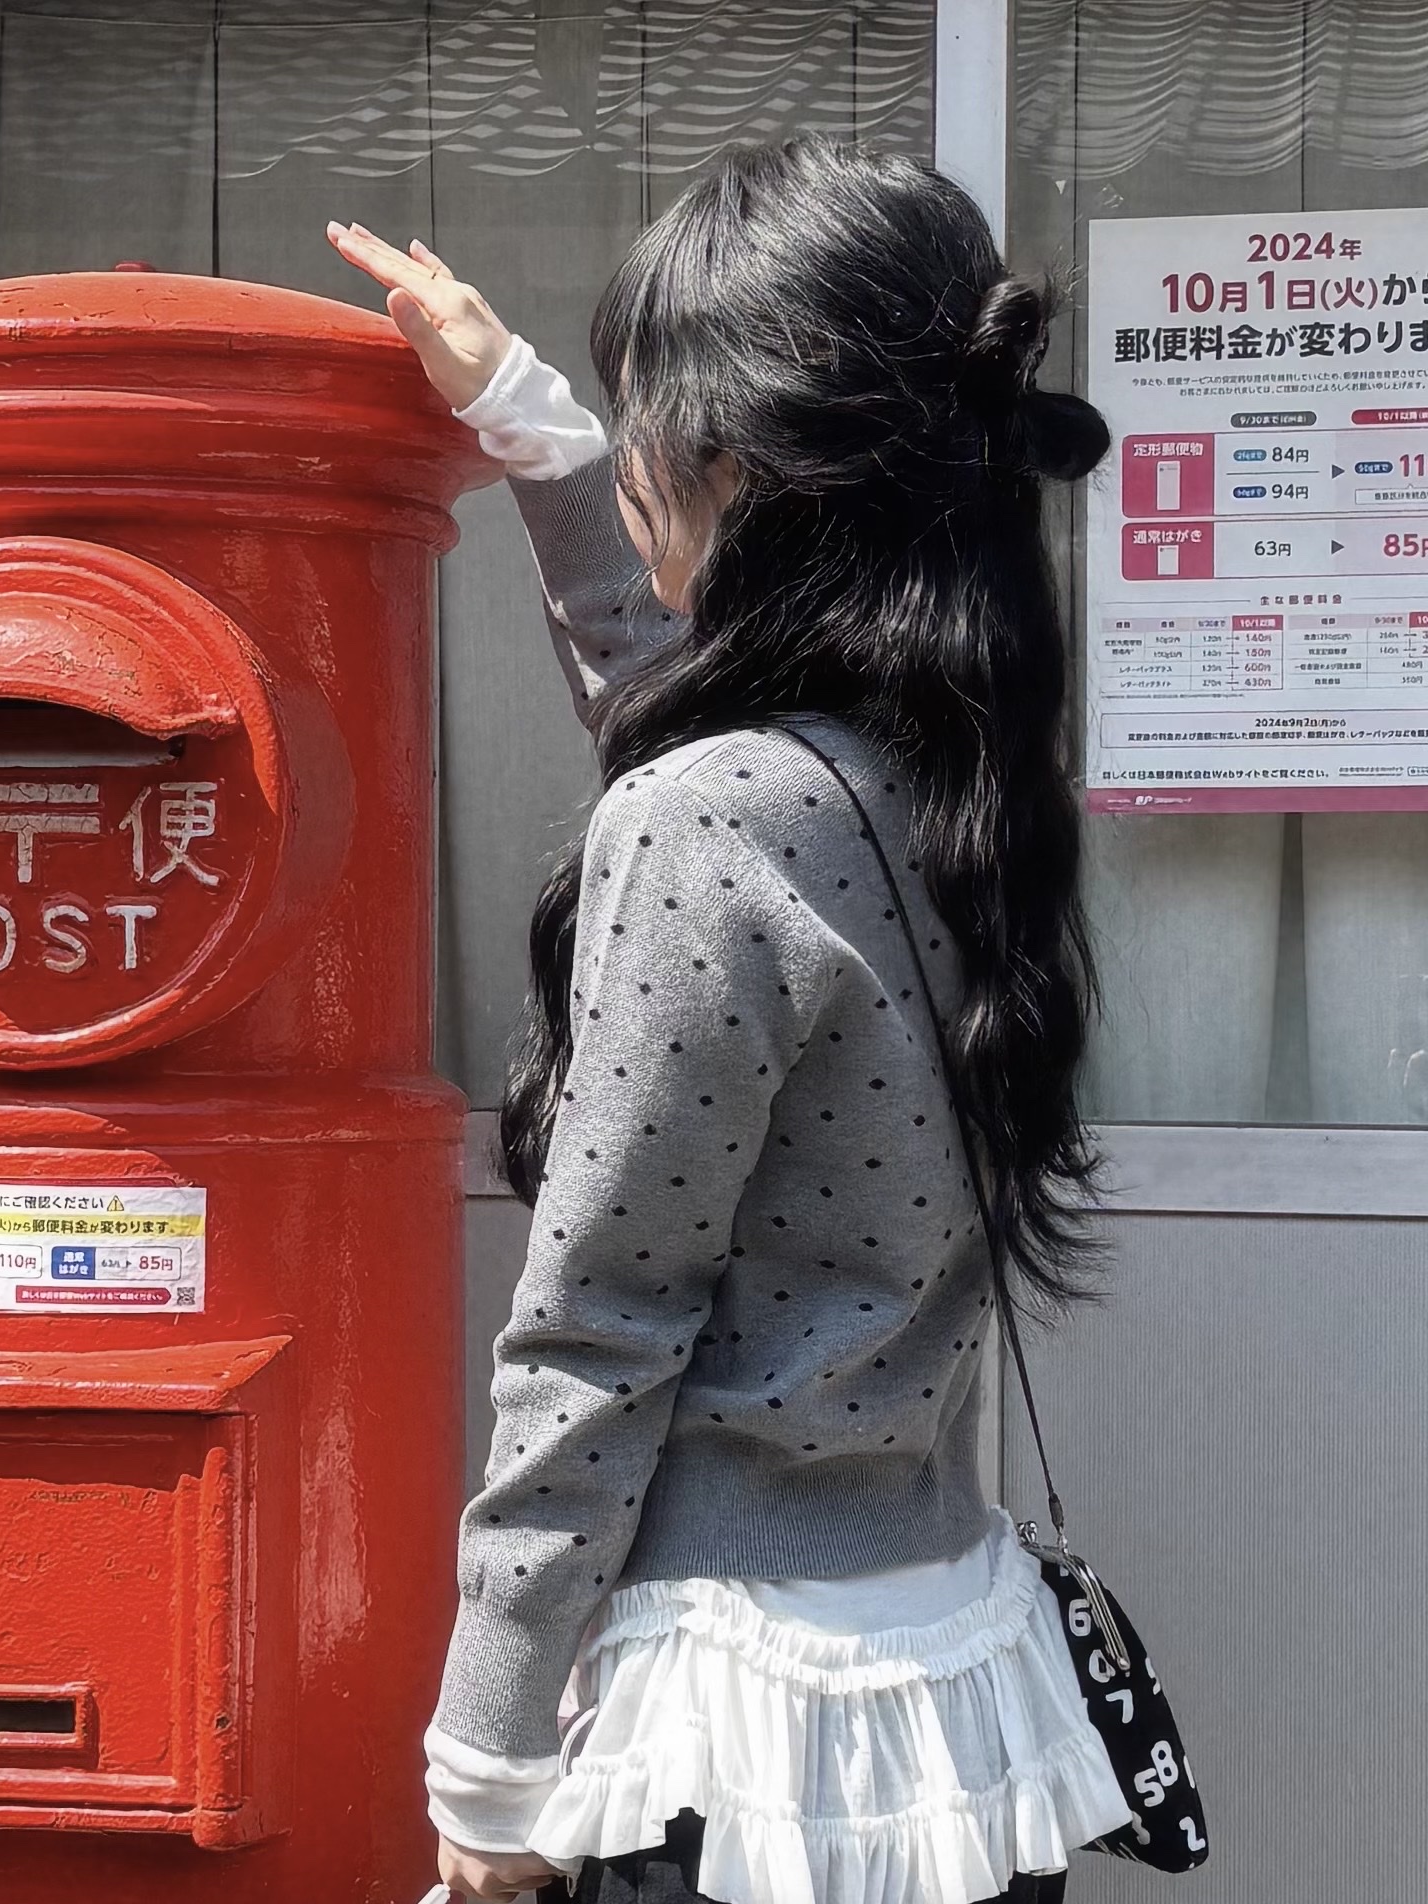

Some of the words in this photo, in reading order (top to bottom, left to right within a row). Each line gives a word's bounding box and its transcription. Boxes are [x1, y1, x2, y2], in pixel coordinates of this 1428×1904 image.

[1246, 231, 1362, 263] 2024年
[1271, 446, 1310, 463] 84円
[1271, 483, 1310, 500] 94円
[1254, 540, 1292, 557] 63円
[138, 1255, 174, 1271] 85円
[1068, 1598, 1092, 1637] 6
[1105, 1688, 1134, 1724] 7
[1150, 1740, 1179, 1787] 8
[1133, 1767, 1166, 1807] 5
